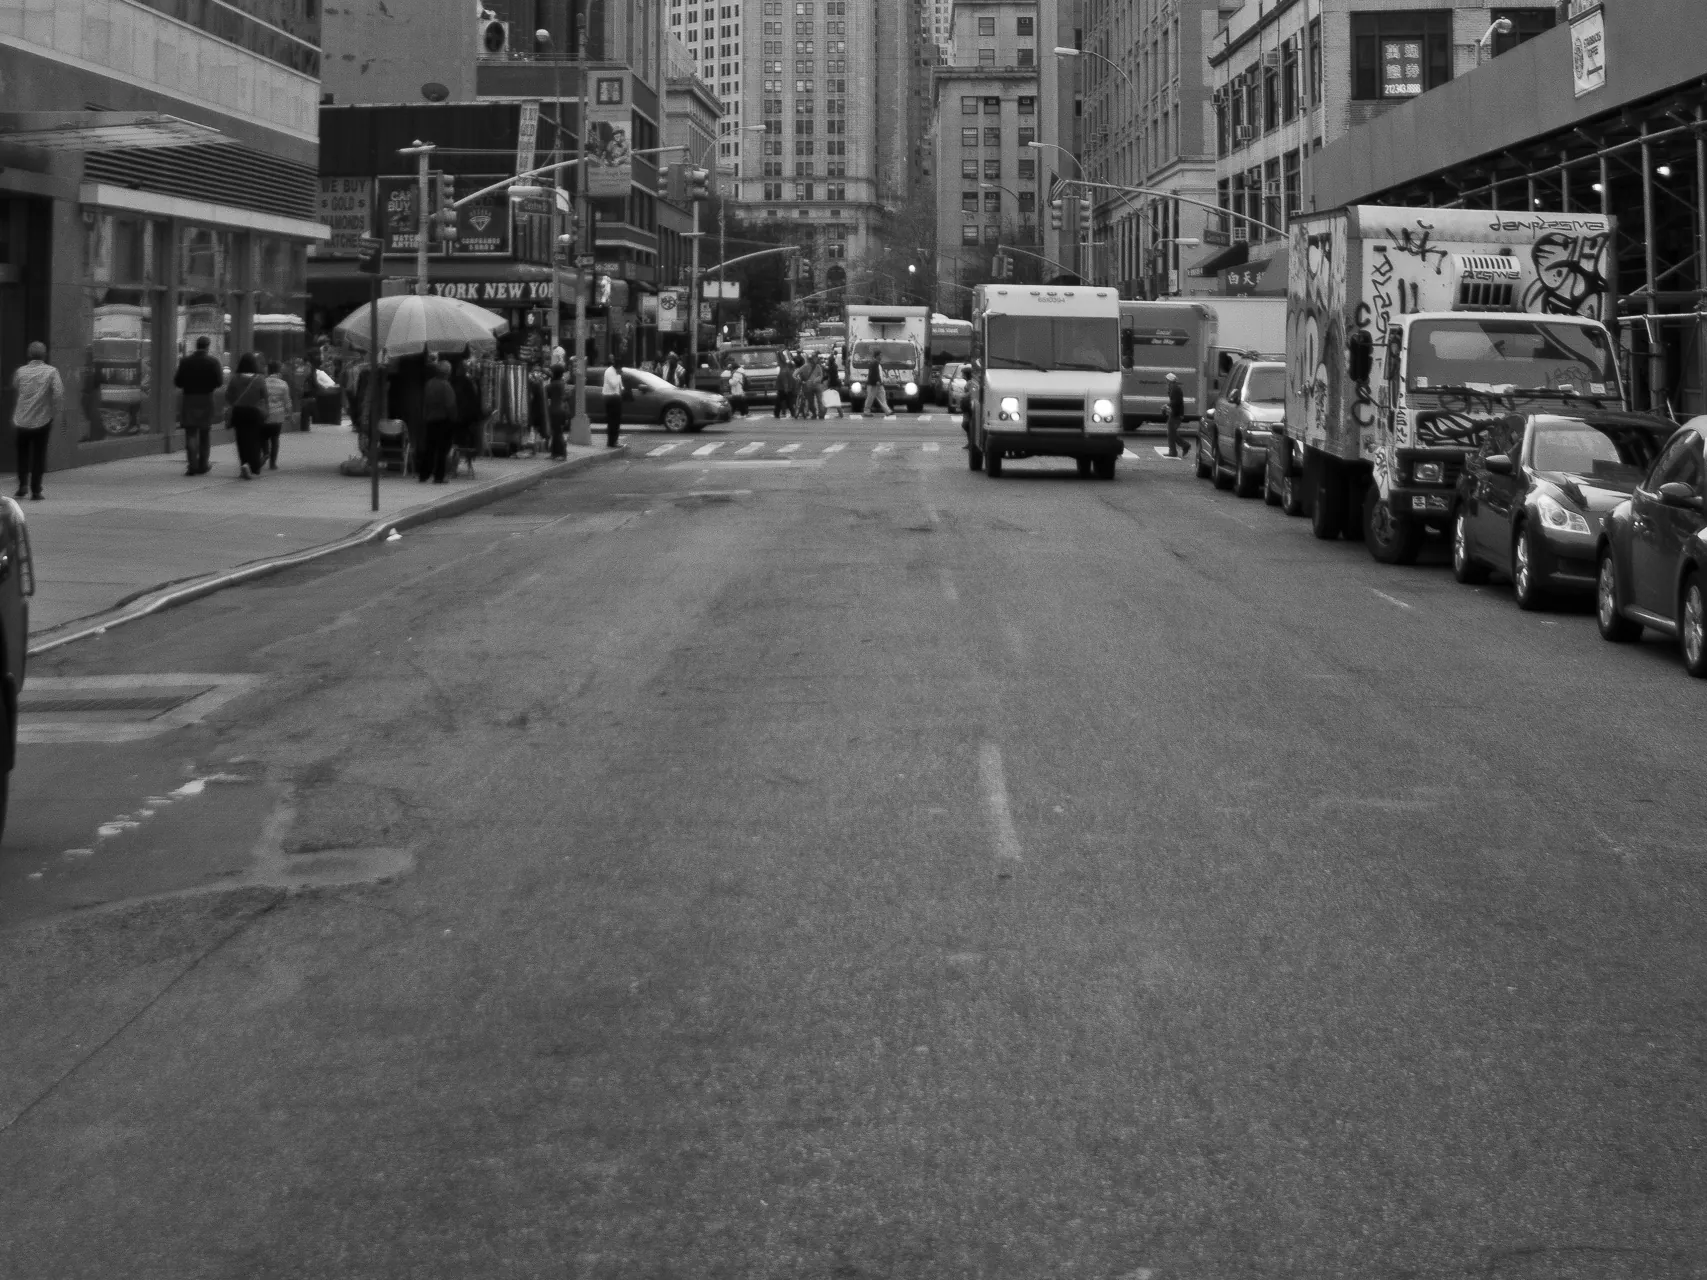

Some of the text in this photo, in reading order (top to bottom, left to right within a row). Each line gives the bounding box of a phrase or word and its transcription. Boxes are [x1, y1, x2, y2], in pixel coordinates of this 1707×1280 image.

[322, 179, 366, 194] WE BUY
[331, 196, 355, 211] GOLD
[434, 282, 479, 299] YORK
[484, 282, 525, 299] NEW
